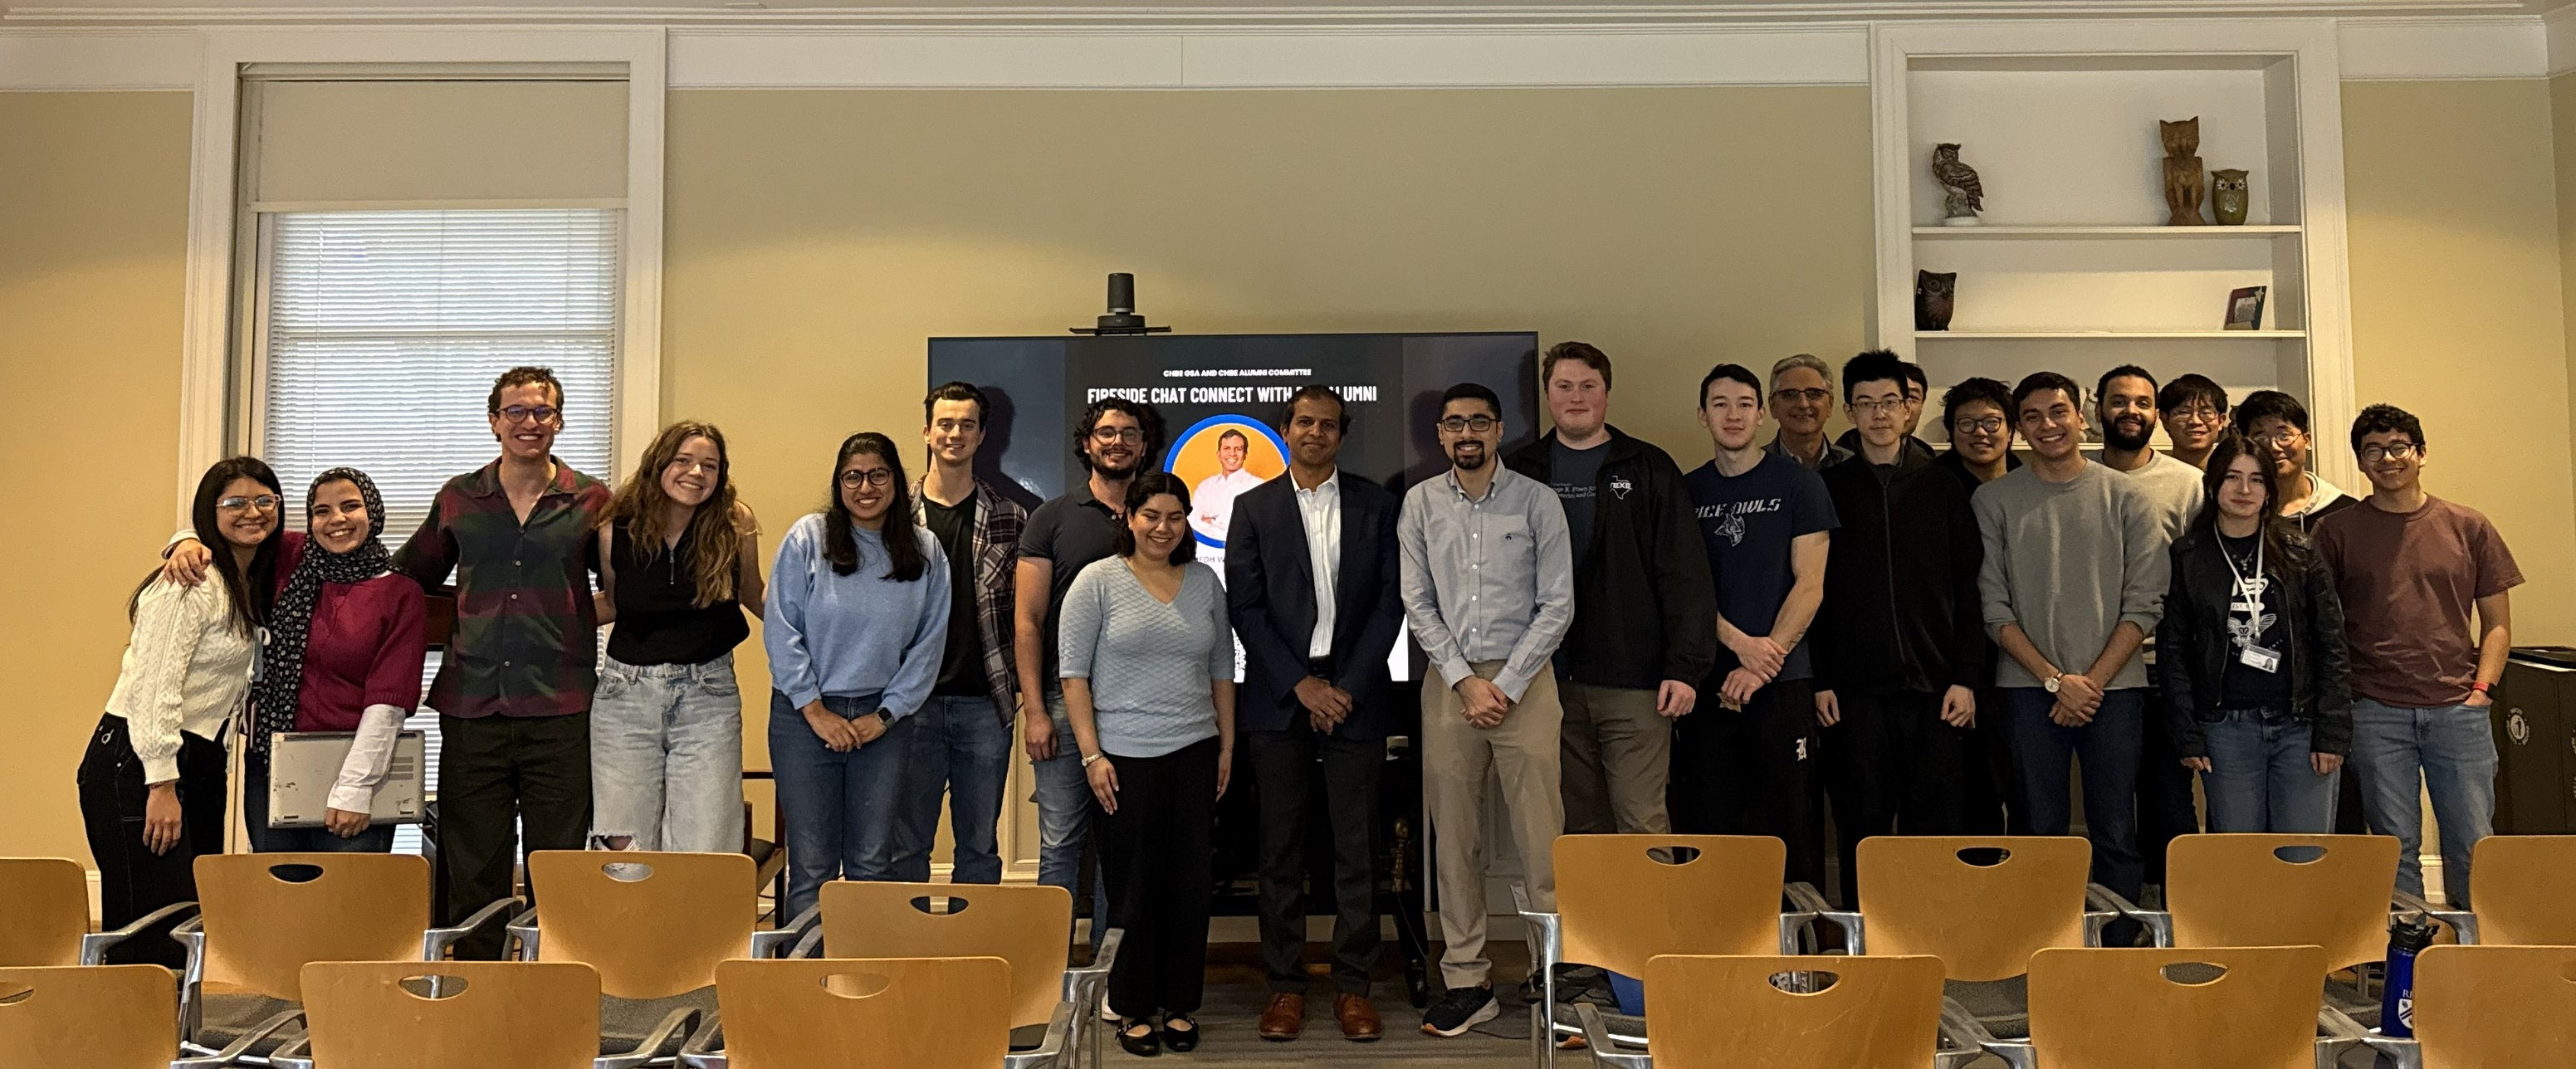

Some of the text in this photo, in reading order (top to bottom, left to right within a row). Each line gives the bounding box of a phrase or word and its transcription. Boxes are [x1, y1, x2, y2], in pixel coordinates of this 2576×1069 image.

[1239, 369, 1267, 377] ALUMNI
[1151, 388, 1186, 404] CHAT
[1190, 387, 1254, 403] CONNECT
[1257, 387, 1293, 403] WITH
[1328, 385, 1377, 403] UMNI
[1694, 498, 1782, 519] ICE OWLS
